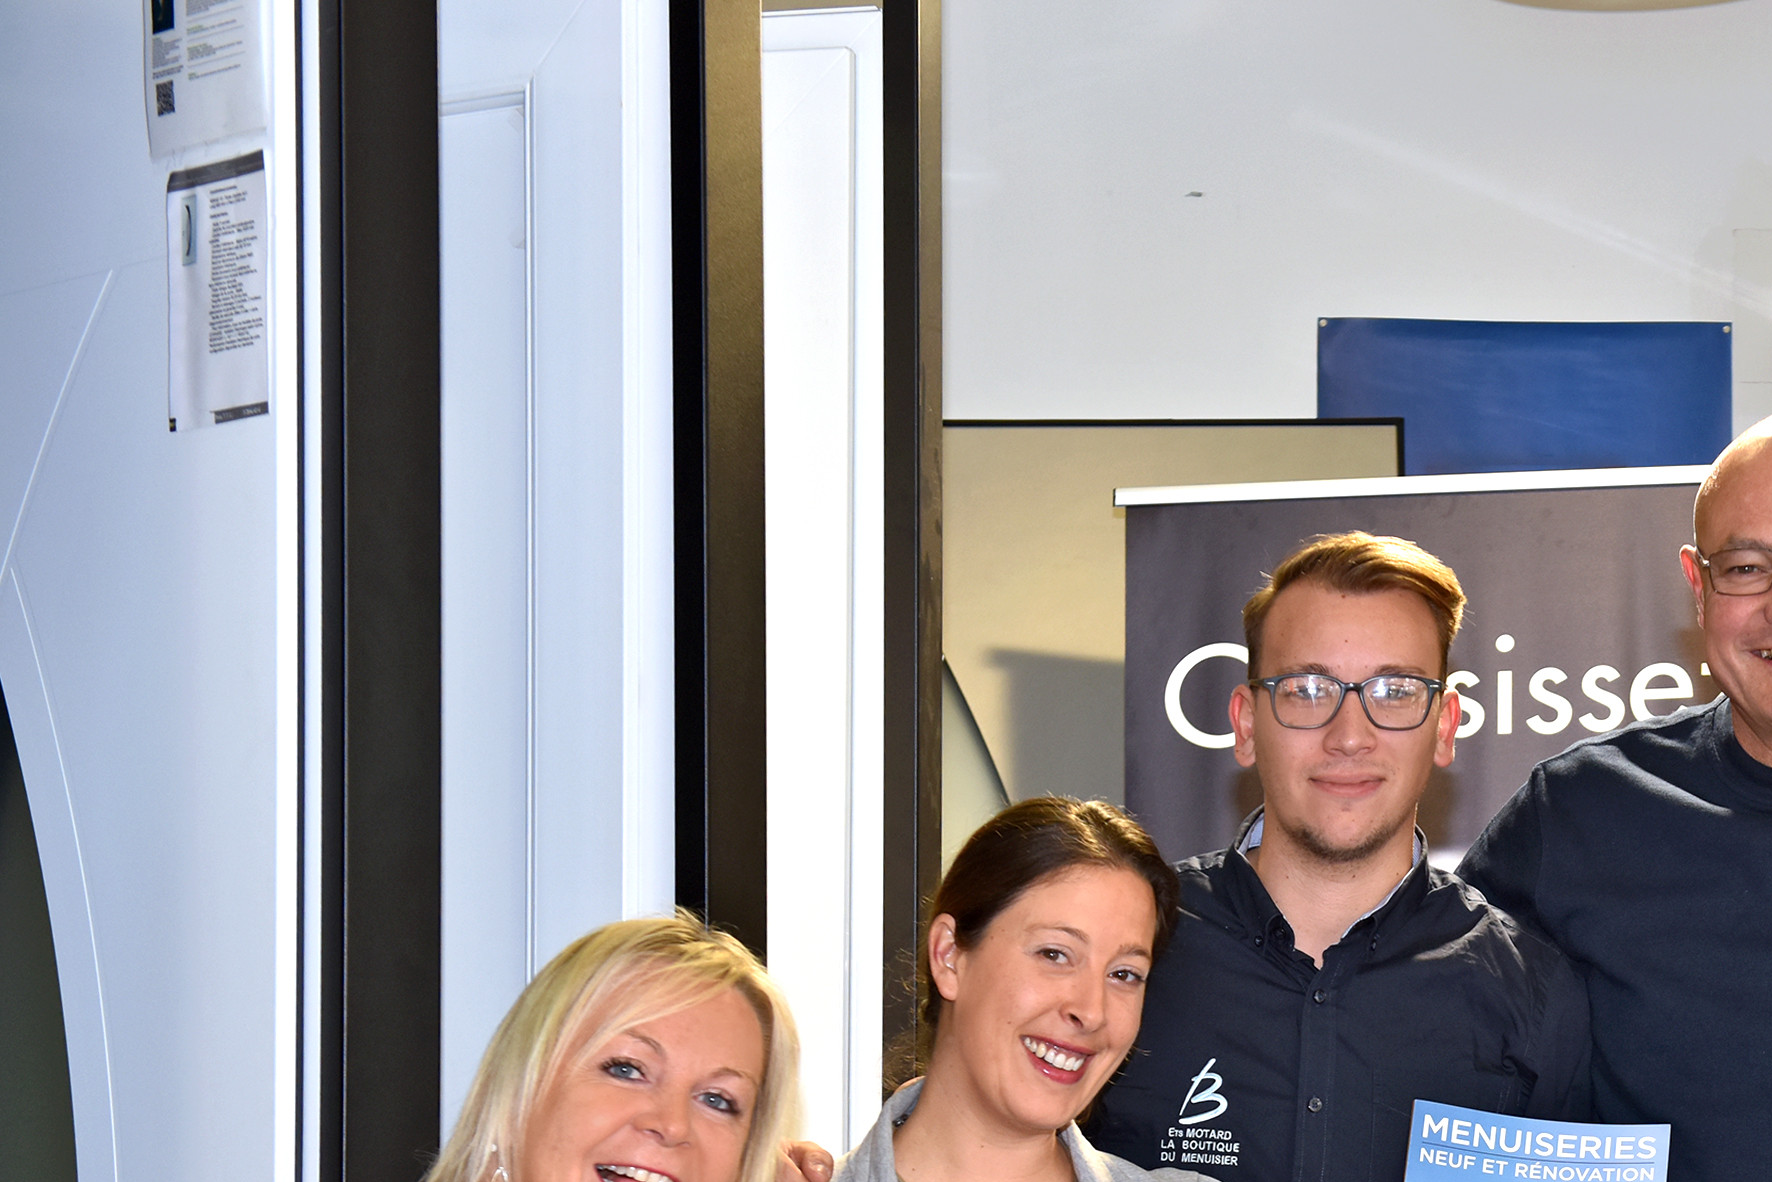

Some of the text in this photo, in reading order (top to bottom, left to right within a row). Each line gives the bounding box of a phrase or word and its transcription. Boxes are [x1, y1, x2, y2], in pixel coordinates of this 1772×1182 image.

[1164, 633, 1712, 750] Csisse
[1178, 1057, 1229, 1125] B
[1160, 1139, 1240, 1153] LA BOUTIQUE
[1186, 1128, 1232, 1140] MOTARD
[1421, 1113, 1657, 1160] MENUISERIES
[1160, 1151, 1239, 1166] DU MENUISIER
[1419, 1147, 1655, 1182] NEUF ET RÉNOVATION
